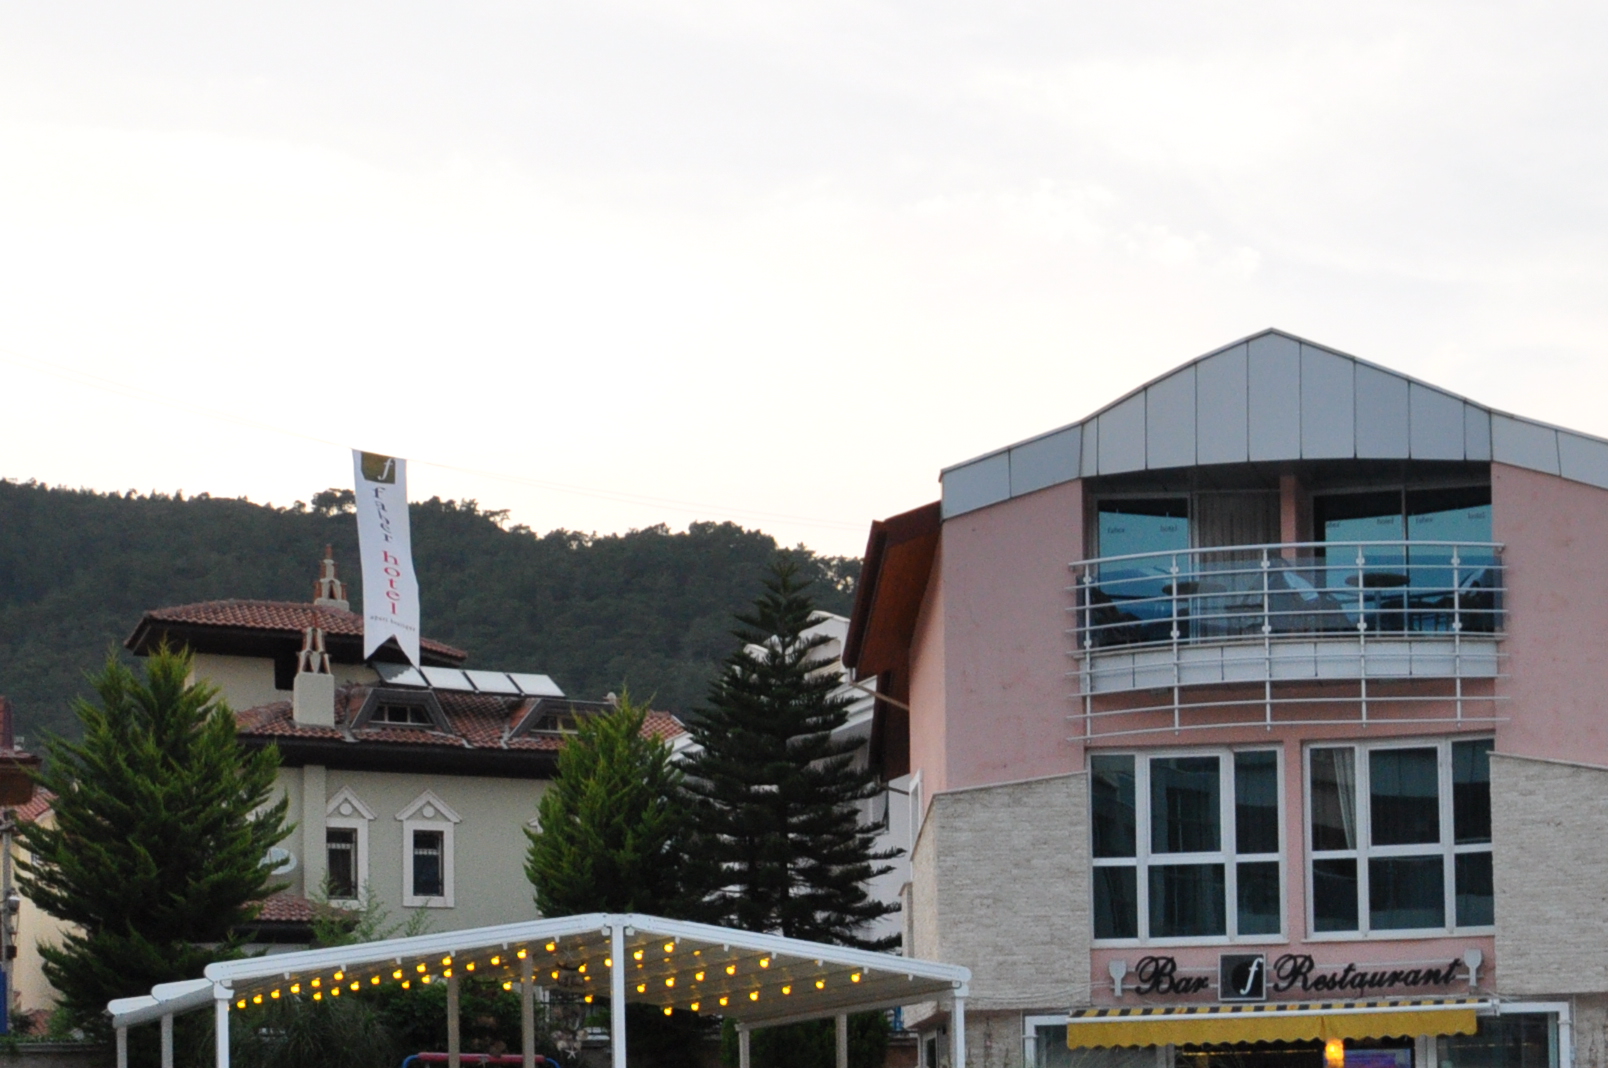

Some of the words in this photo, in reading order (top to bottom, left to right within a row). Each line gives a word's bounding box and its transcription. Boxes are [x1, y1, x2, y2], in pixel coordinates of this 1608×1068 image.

[382, 550, 401, 616] hotel
[1135, 955, 1209, 995] Bar
[1239, 957, 1264, 996] f
[1273, 953, 1462, 993] Restaurant
